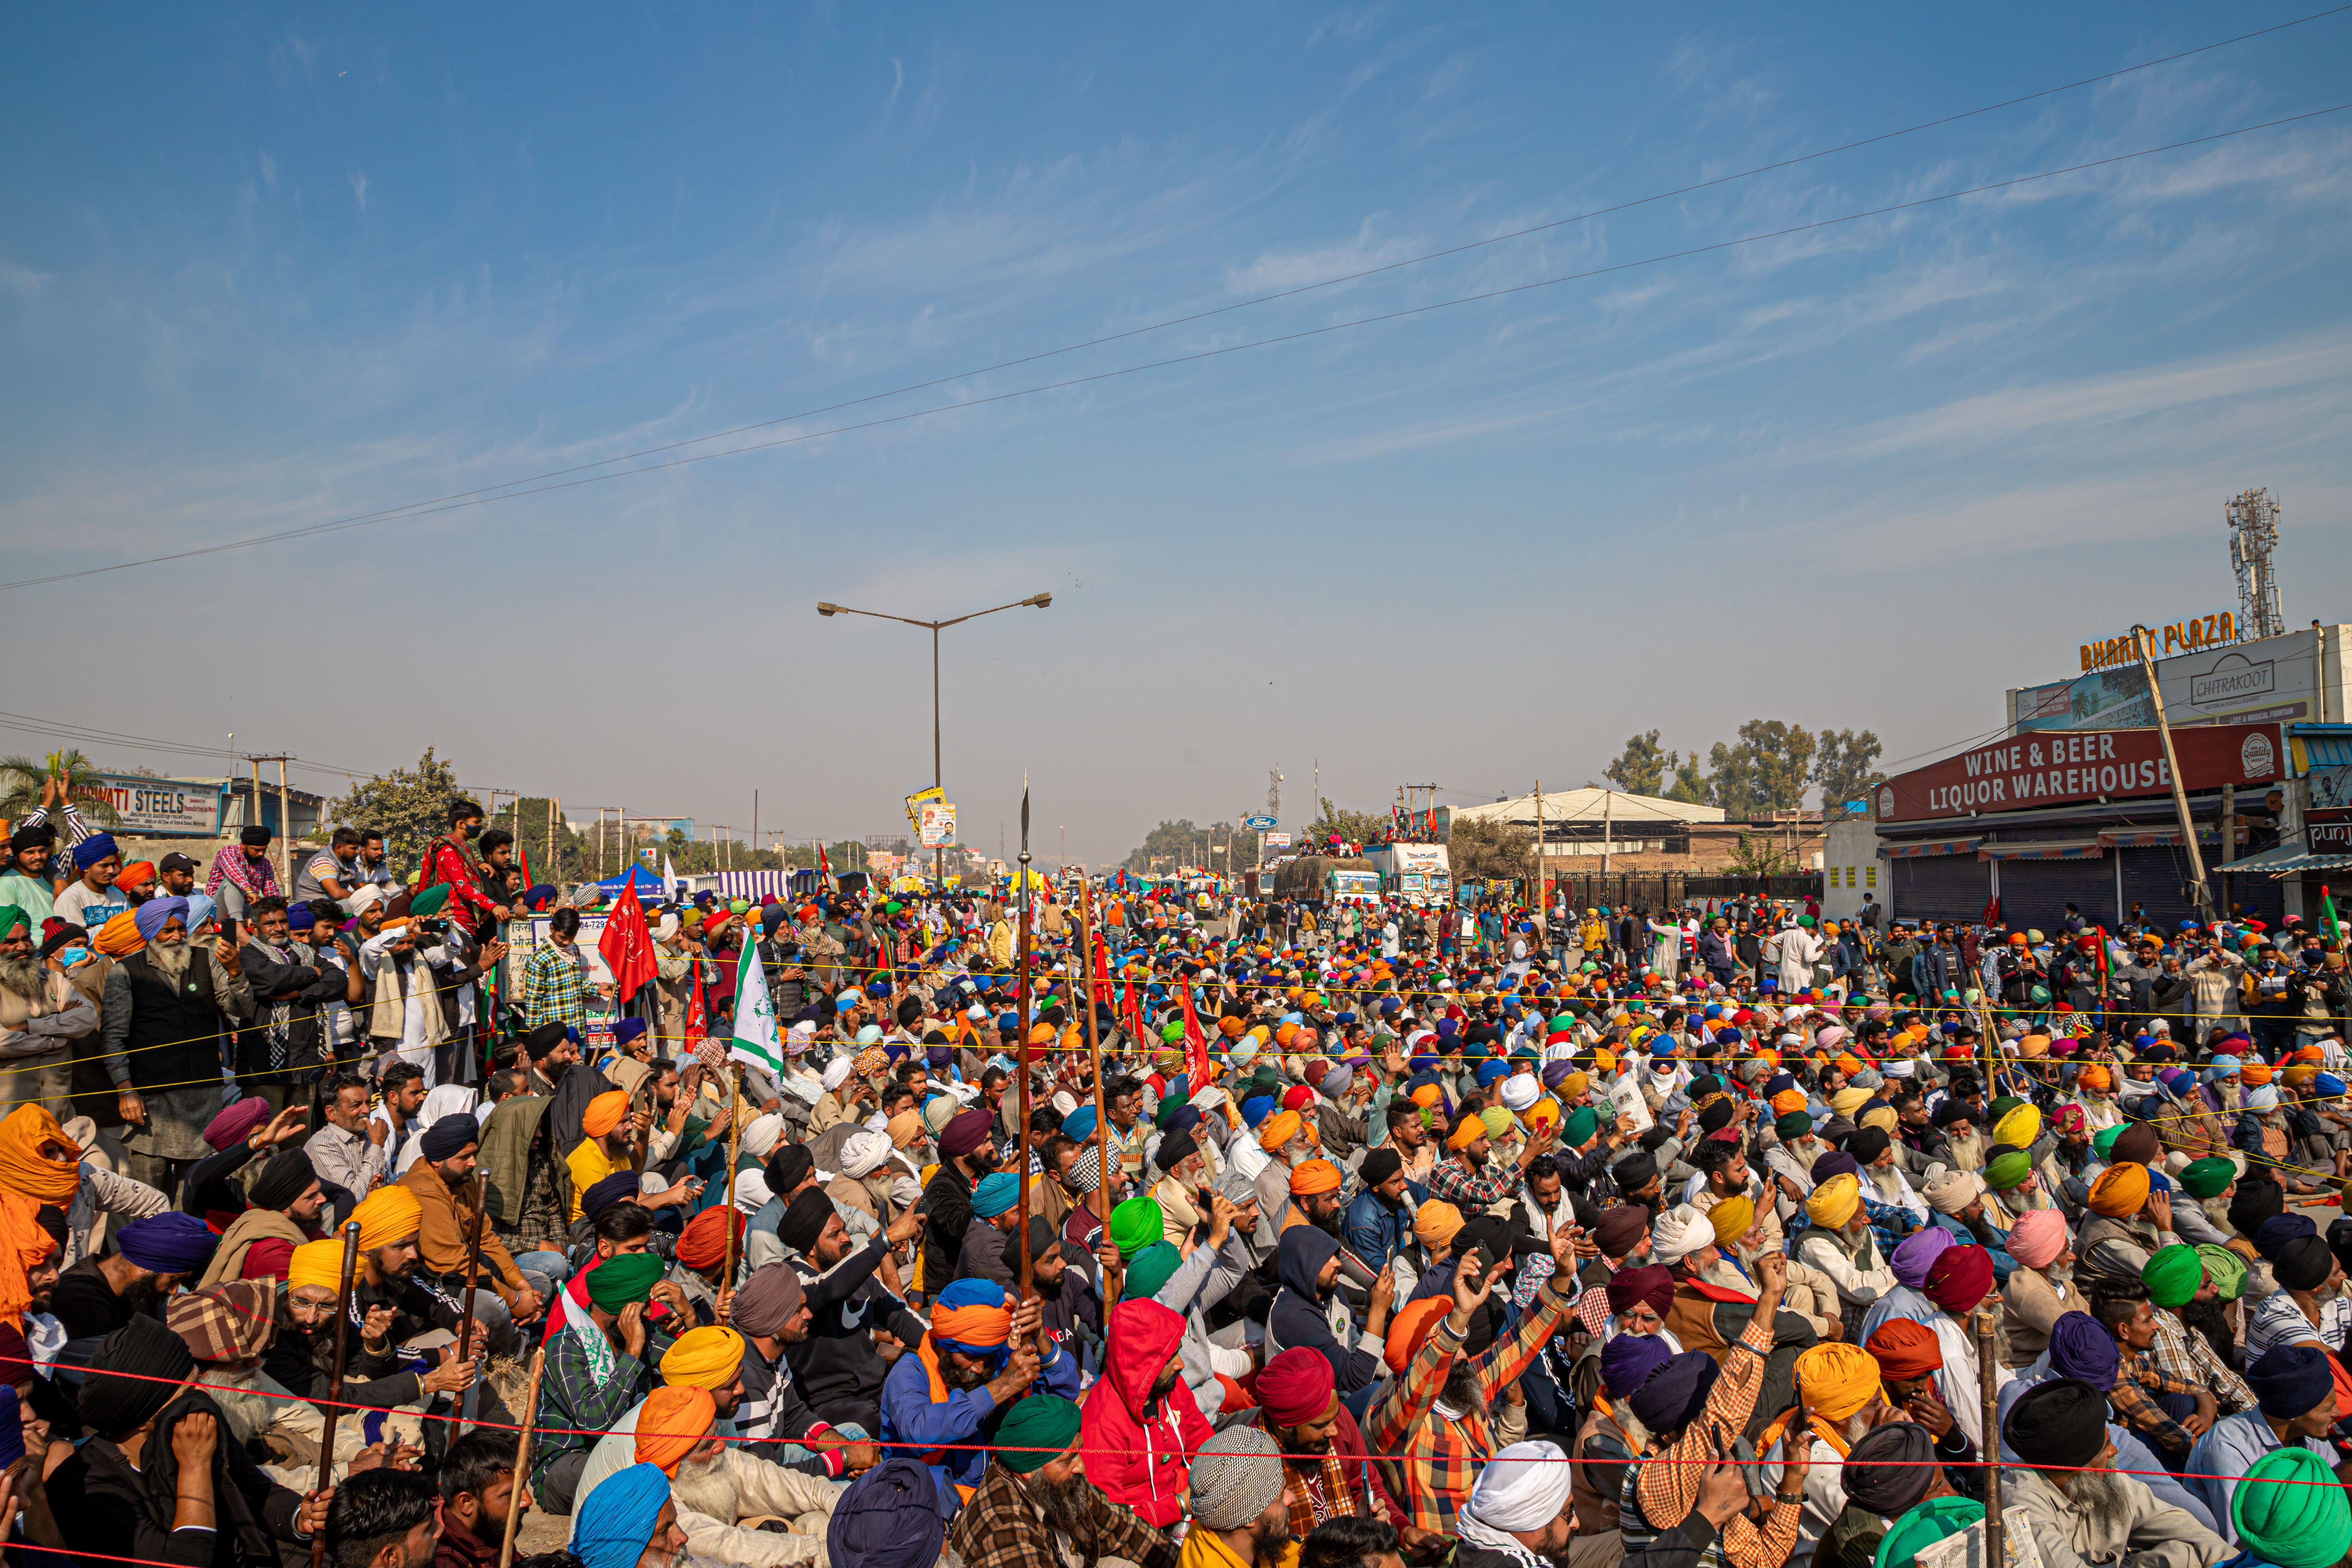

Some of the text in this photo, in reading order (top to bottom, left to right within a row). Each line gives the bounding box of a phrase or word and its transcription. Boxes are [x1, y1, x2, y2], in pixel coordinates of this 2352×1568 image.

[2080, 611, 2234, 671] BHARAT PLAZA
[2197, 669, 2268, 697] CHITRAKOOT
[2248, 711, 2269, 722] MUSICAL
[2270, 707, 2294, 718] FOUNTAIN
[2245, 734, 2268, 745] SATISFACTION
[1965, 734, 2116, 777] WINE & BEER
[2244, 746, 2271, 759] Quality
[2246, 764, 2272, 777] GUARANTEED
[1930, 778, 2006, 812] LIQUOR
[2012, 758, 2171, 798] WAREHOUSE
[136, 790, 185, 815] STEELS
[585, 1034, 617, 1042] azaar.in
[1185, 1039, 1194, 1054] ਸਾਨ
